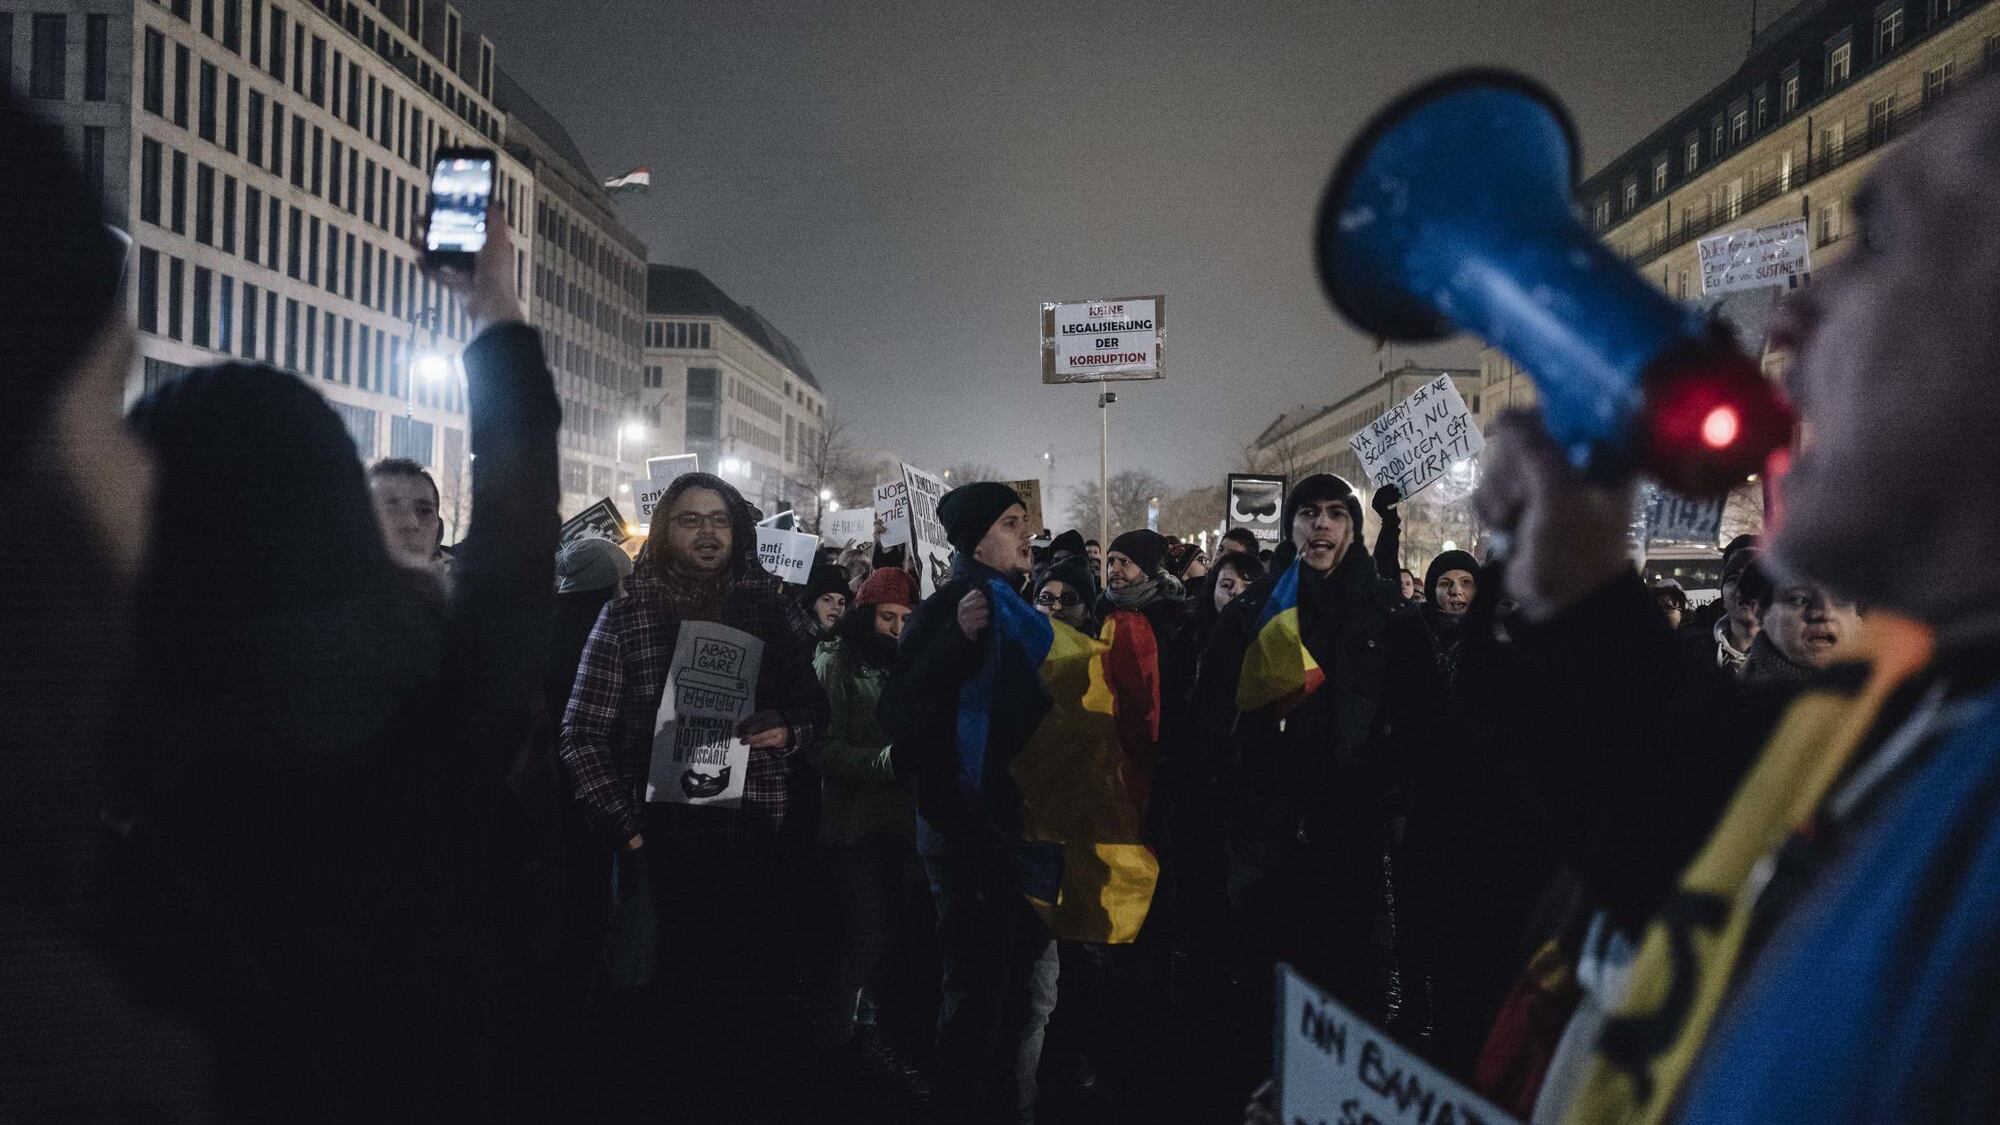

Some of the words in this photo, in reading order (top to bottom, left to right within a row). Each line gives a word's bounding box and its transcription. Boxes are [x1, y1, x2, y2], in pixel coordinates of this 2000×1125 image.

[1089, 305, 1124, 317] KEINE
[1062, 320, 1153, 334] LEGALISIERUNG
[1095, 338, 1119, 348] DER
[1069, 352, 1146, 366] KORRUPTION
[1431, 377, 1448, 394] NE
[1424, 399, 1449, 427] NU
[1375, 432, 1443, 487] PRODUCEM
[881, 506, 904, 522] THE
[760, 543, 782, 553] anti
[700, 643, 738, 660] ABRO
[698, 656, 735, 673] GARE
